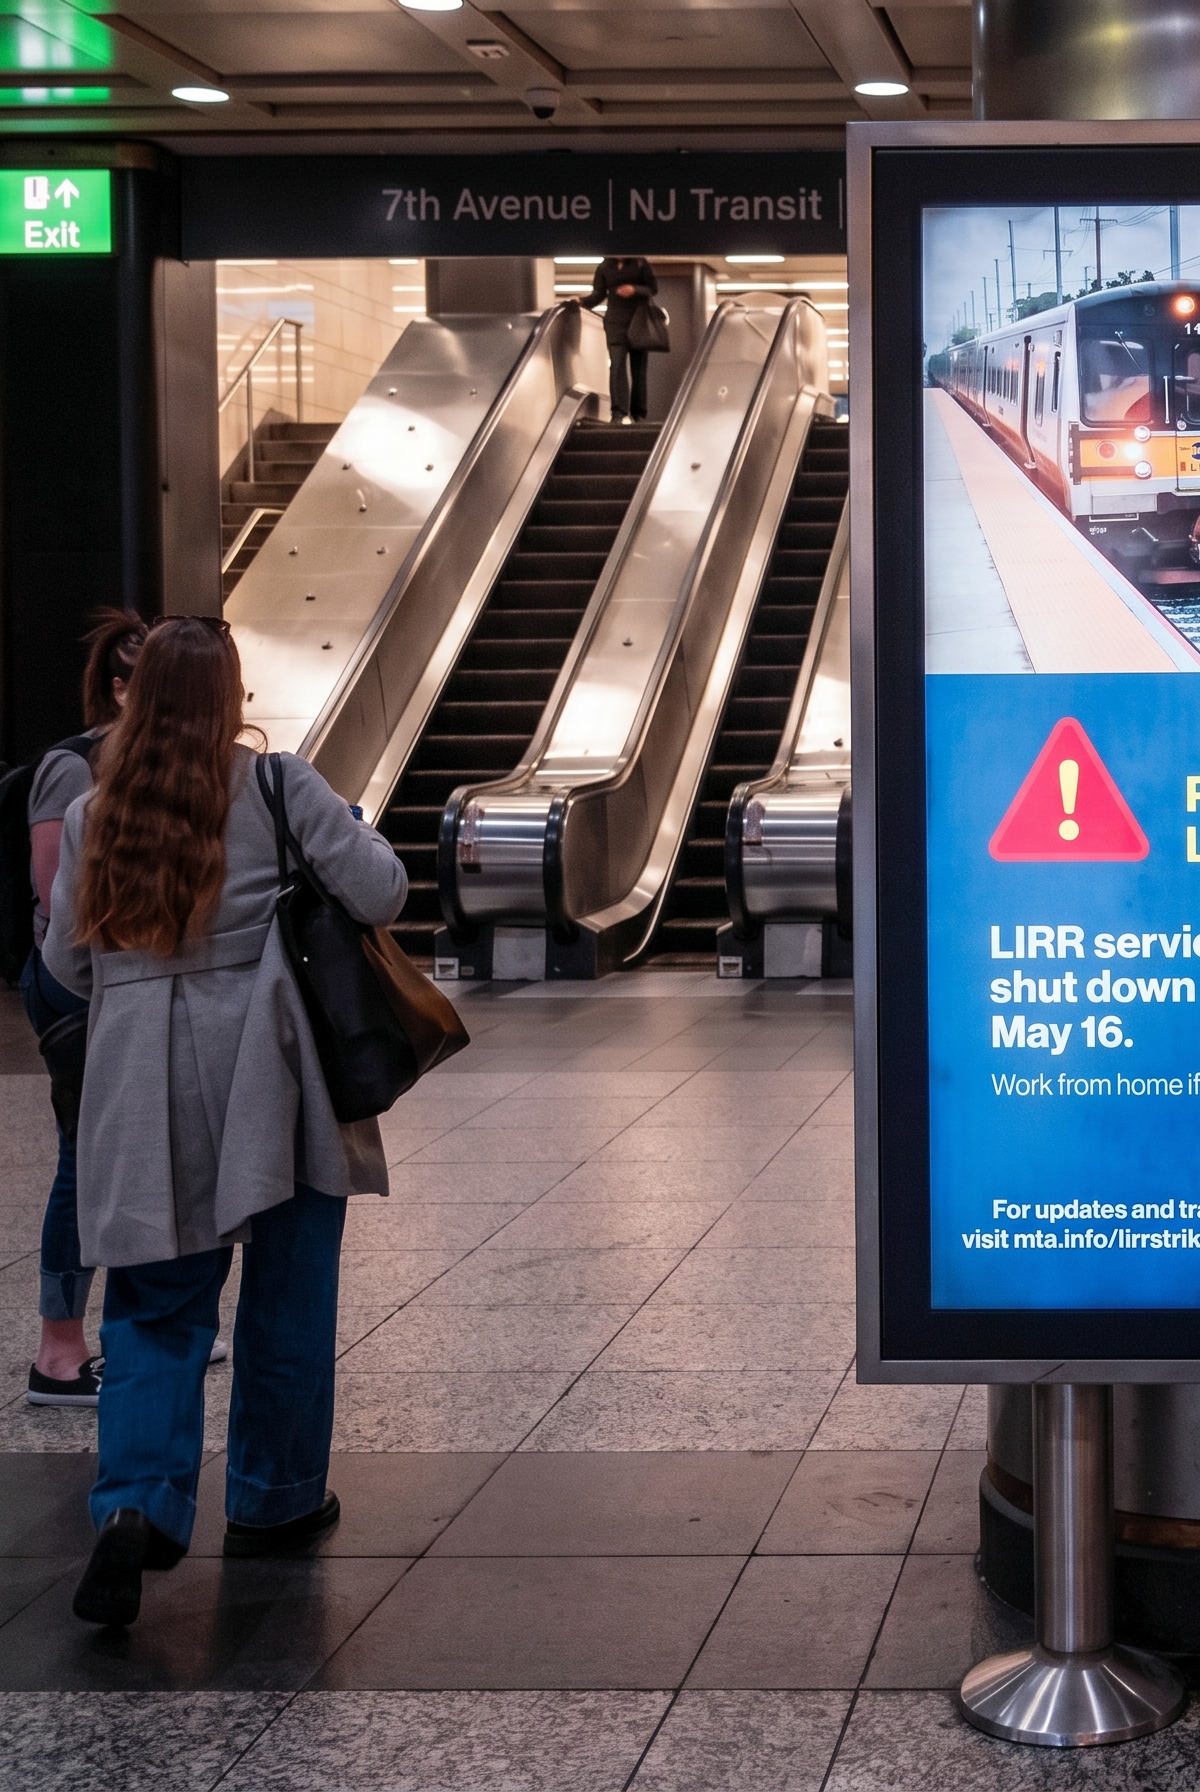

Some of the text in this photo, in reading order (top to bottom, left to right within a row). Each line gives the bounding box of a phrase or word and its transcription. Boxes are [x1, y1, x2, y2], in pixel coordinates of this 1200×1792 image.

[382, 188, 822, 221] 7th Avenue NJ Transit
[25, 221, 80, 248] Exit
[991, 926, 1084, 958] LIRR
[991, 970, 1077, 1003] shut
[1086, 970, 1195, 1003] down
[992, 1016, 1133, 1055] May 16.
[992, 1073, 1053, 1096] Work
[1058, 1073, 1111, 1095] from
[1118, 1073, 1183, 1095] home
[1189, 1072, 1200, 1094] if
[993, 1200, 1031, 1219] For
[1036, 1199, 1127, 1223] updates
[1132, 1199, 1174, 1218] and
[962, 1229, 1009, 1249] visit
